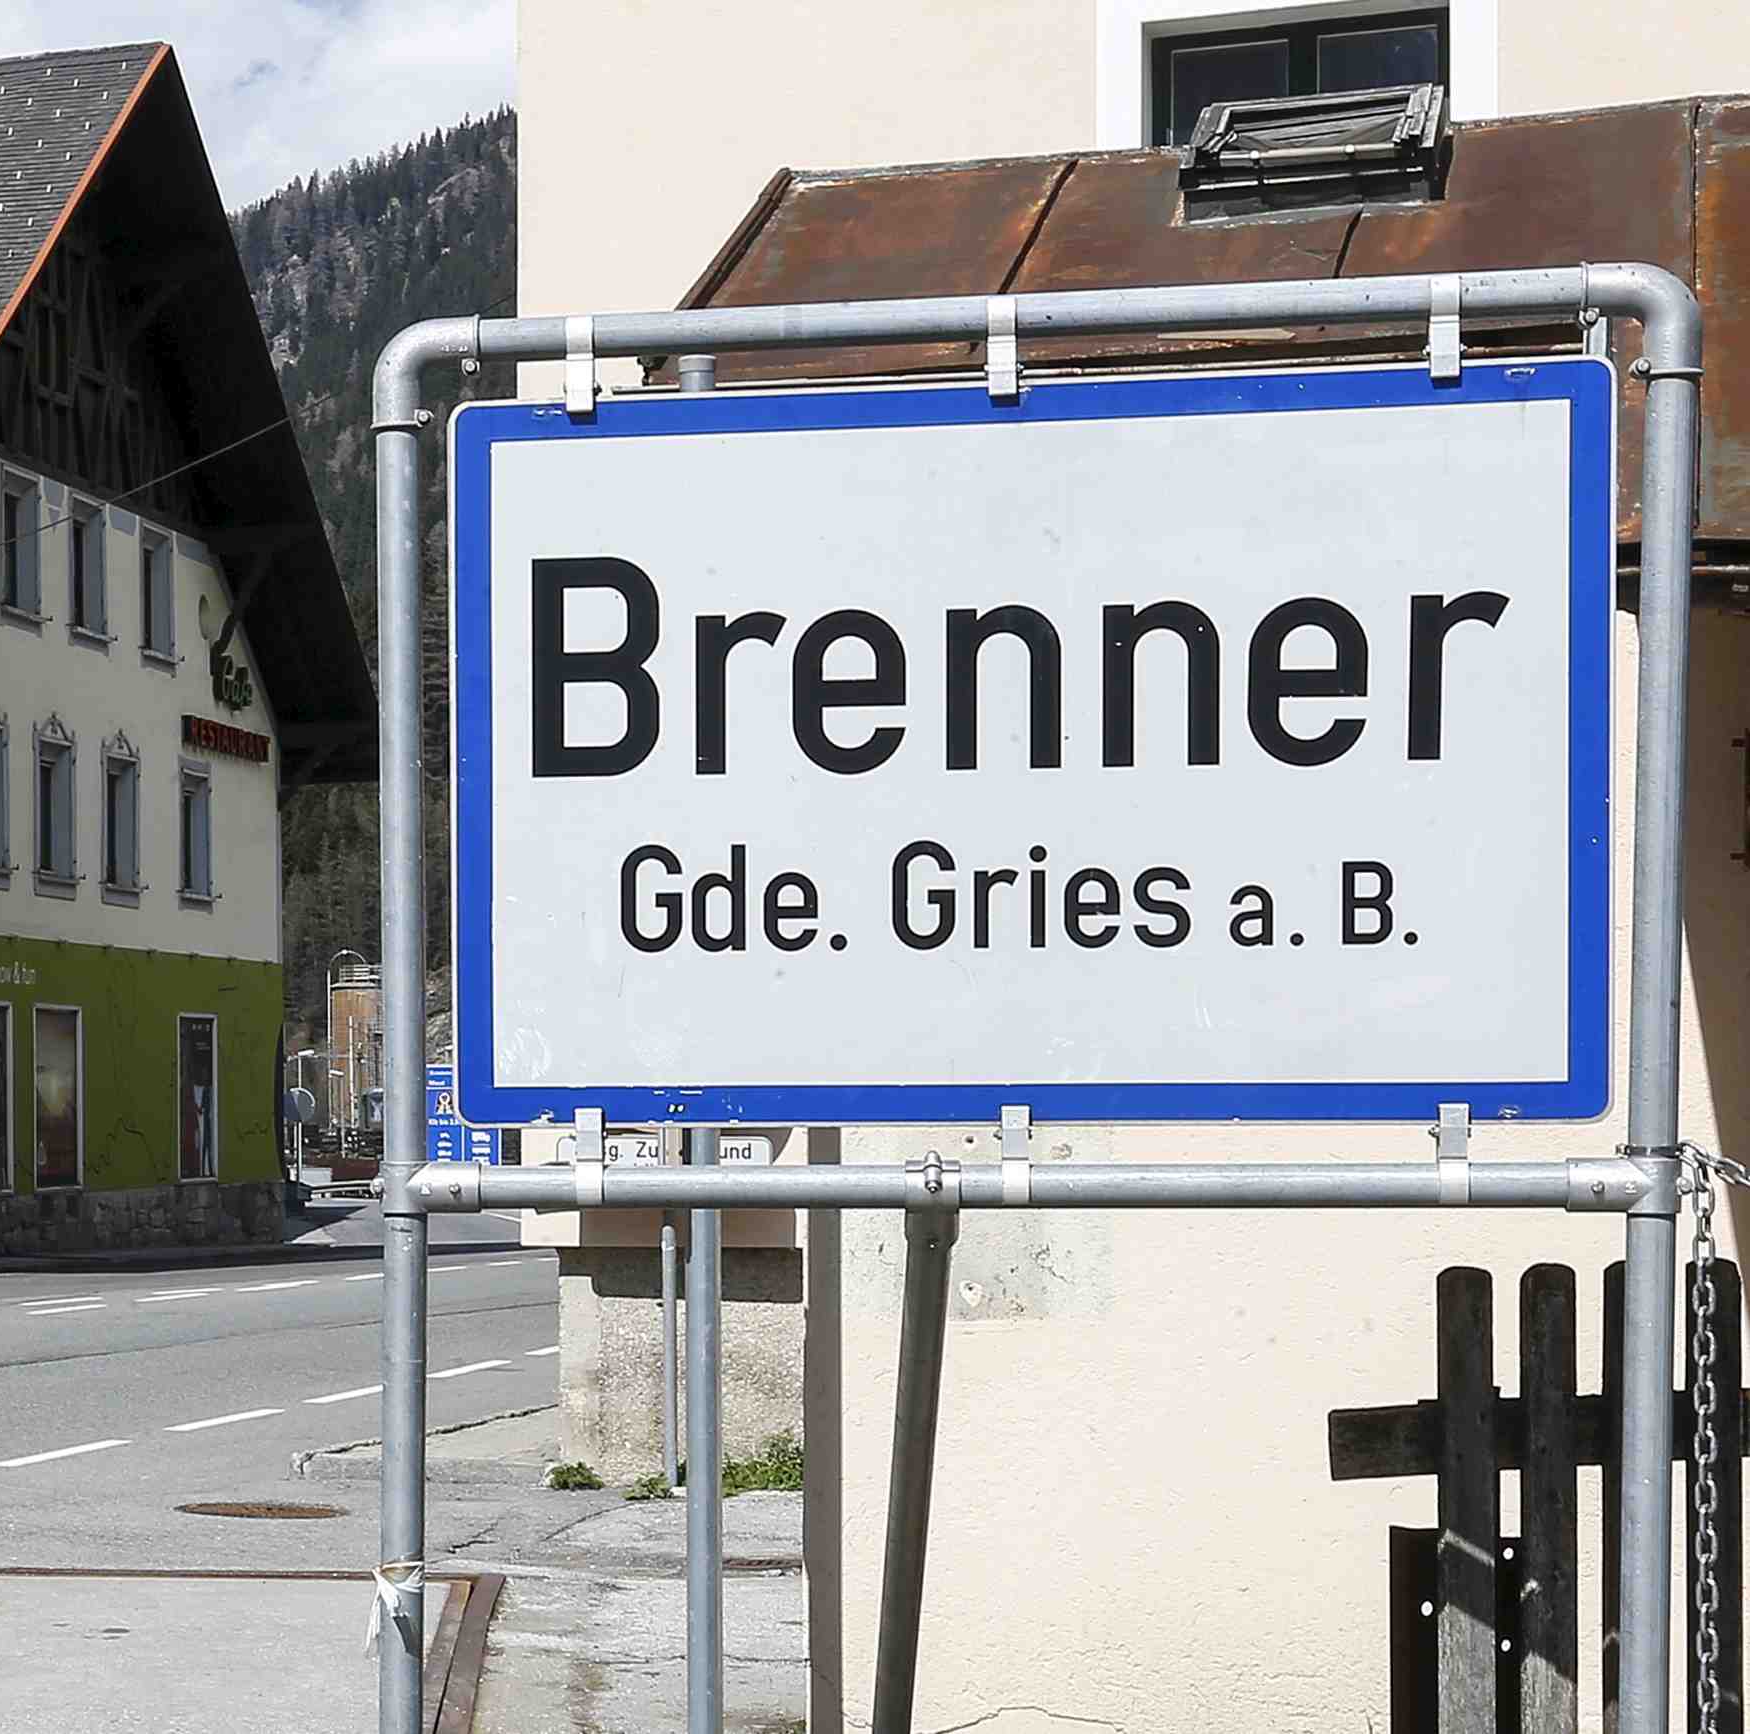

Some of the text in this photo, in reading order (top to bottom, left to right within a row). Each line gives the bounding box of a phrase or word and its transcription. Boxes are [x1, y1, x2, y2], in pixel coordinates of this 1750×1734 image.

[531, 556, 1510, 778] Brenner
[618, 839, 1420, 953] Gde. Gries a. B.
